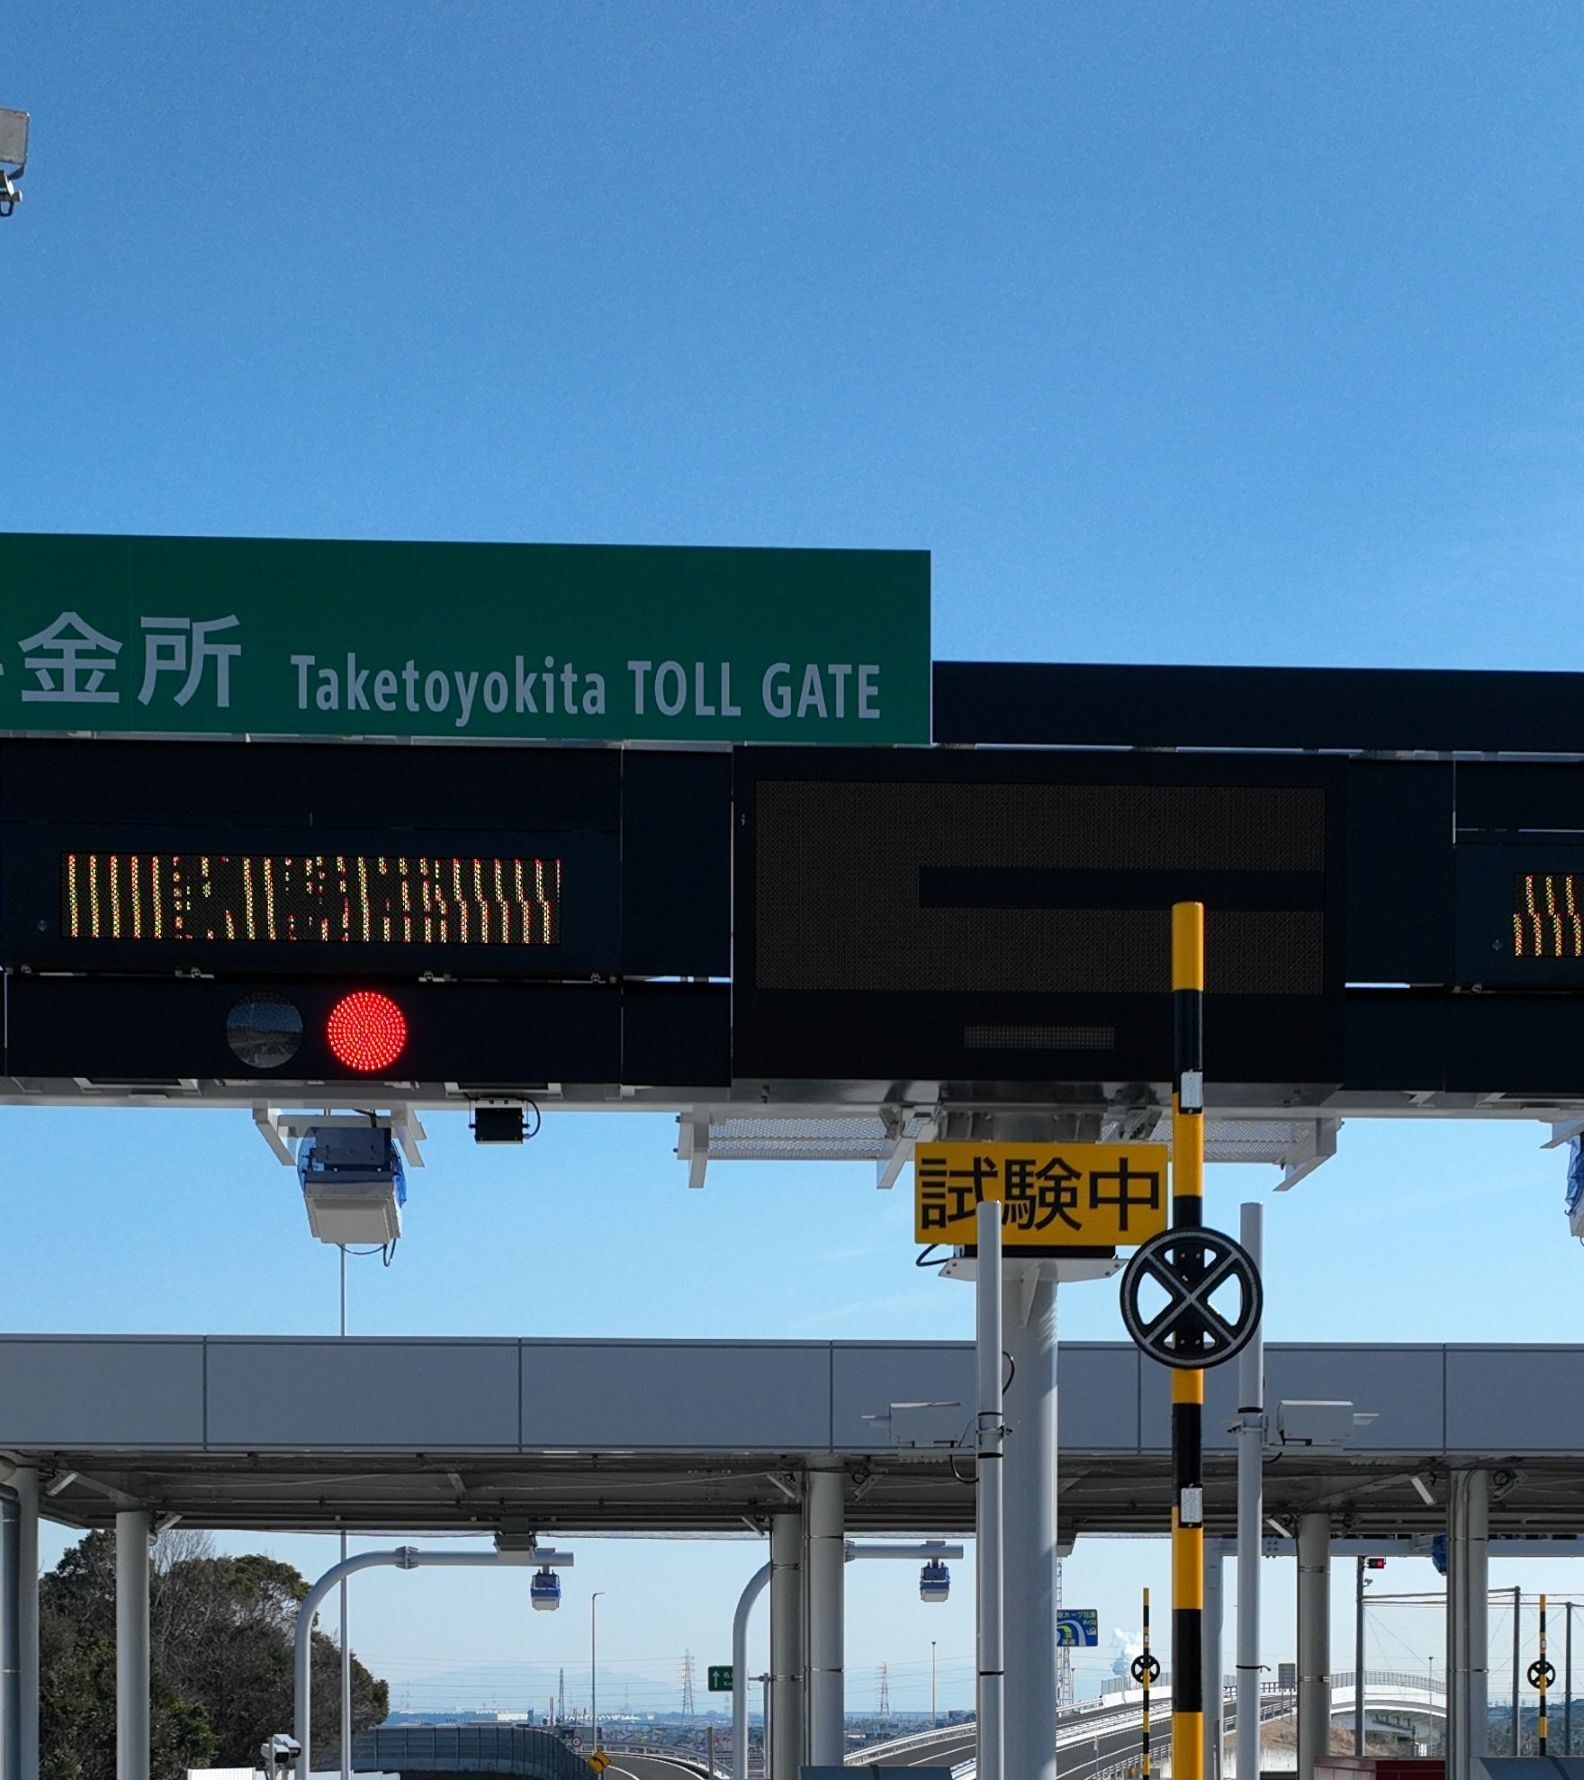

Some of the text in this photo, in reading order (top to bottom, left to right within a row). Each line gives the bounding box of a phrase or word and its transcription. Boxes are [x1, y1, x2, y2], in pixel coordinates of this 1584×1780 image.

[290, 653, 606, 727] Taketoyokita
[627, 660, 742, 716] TOLL
[762, 662, 881, 718] GATE
[918, 1157, 1160, 1232] 試験中
